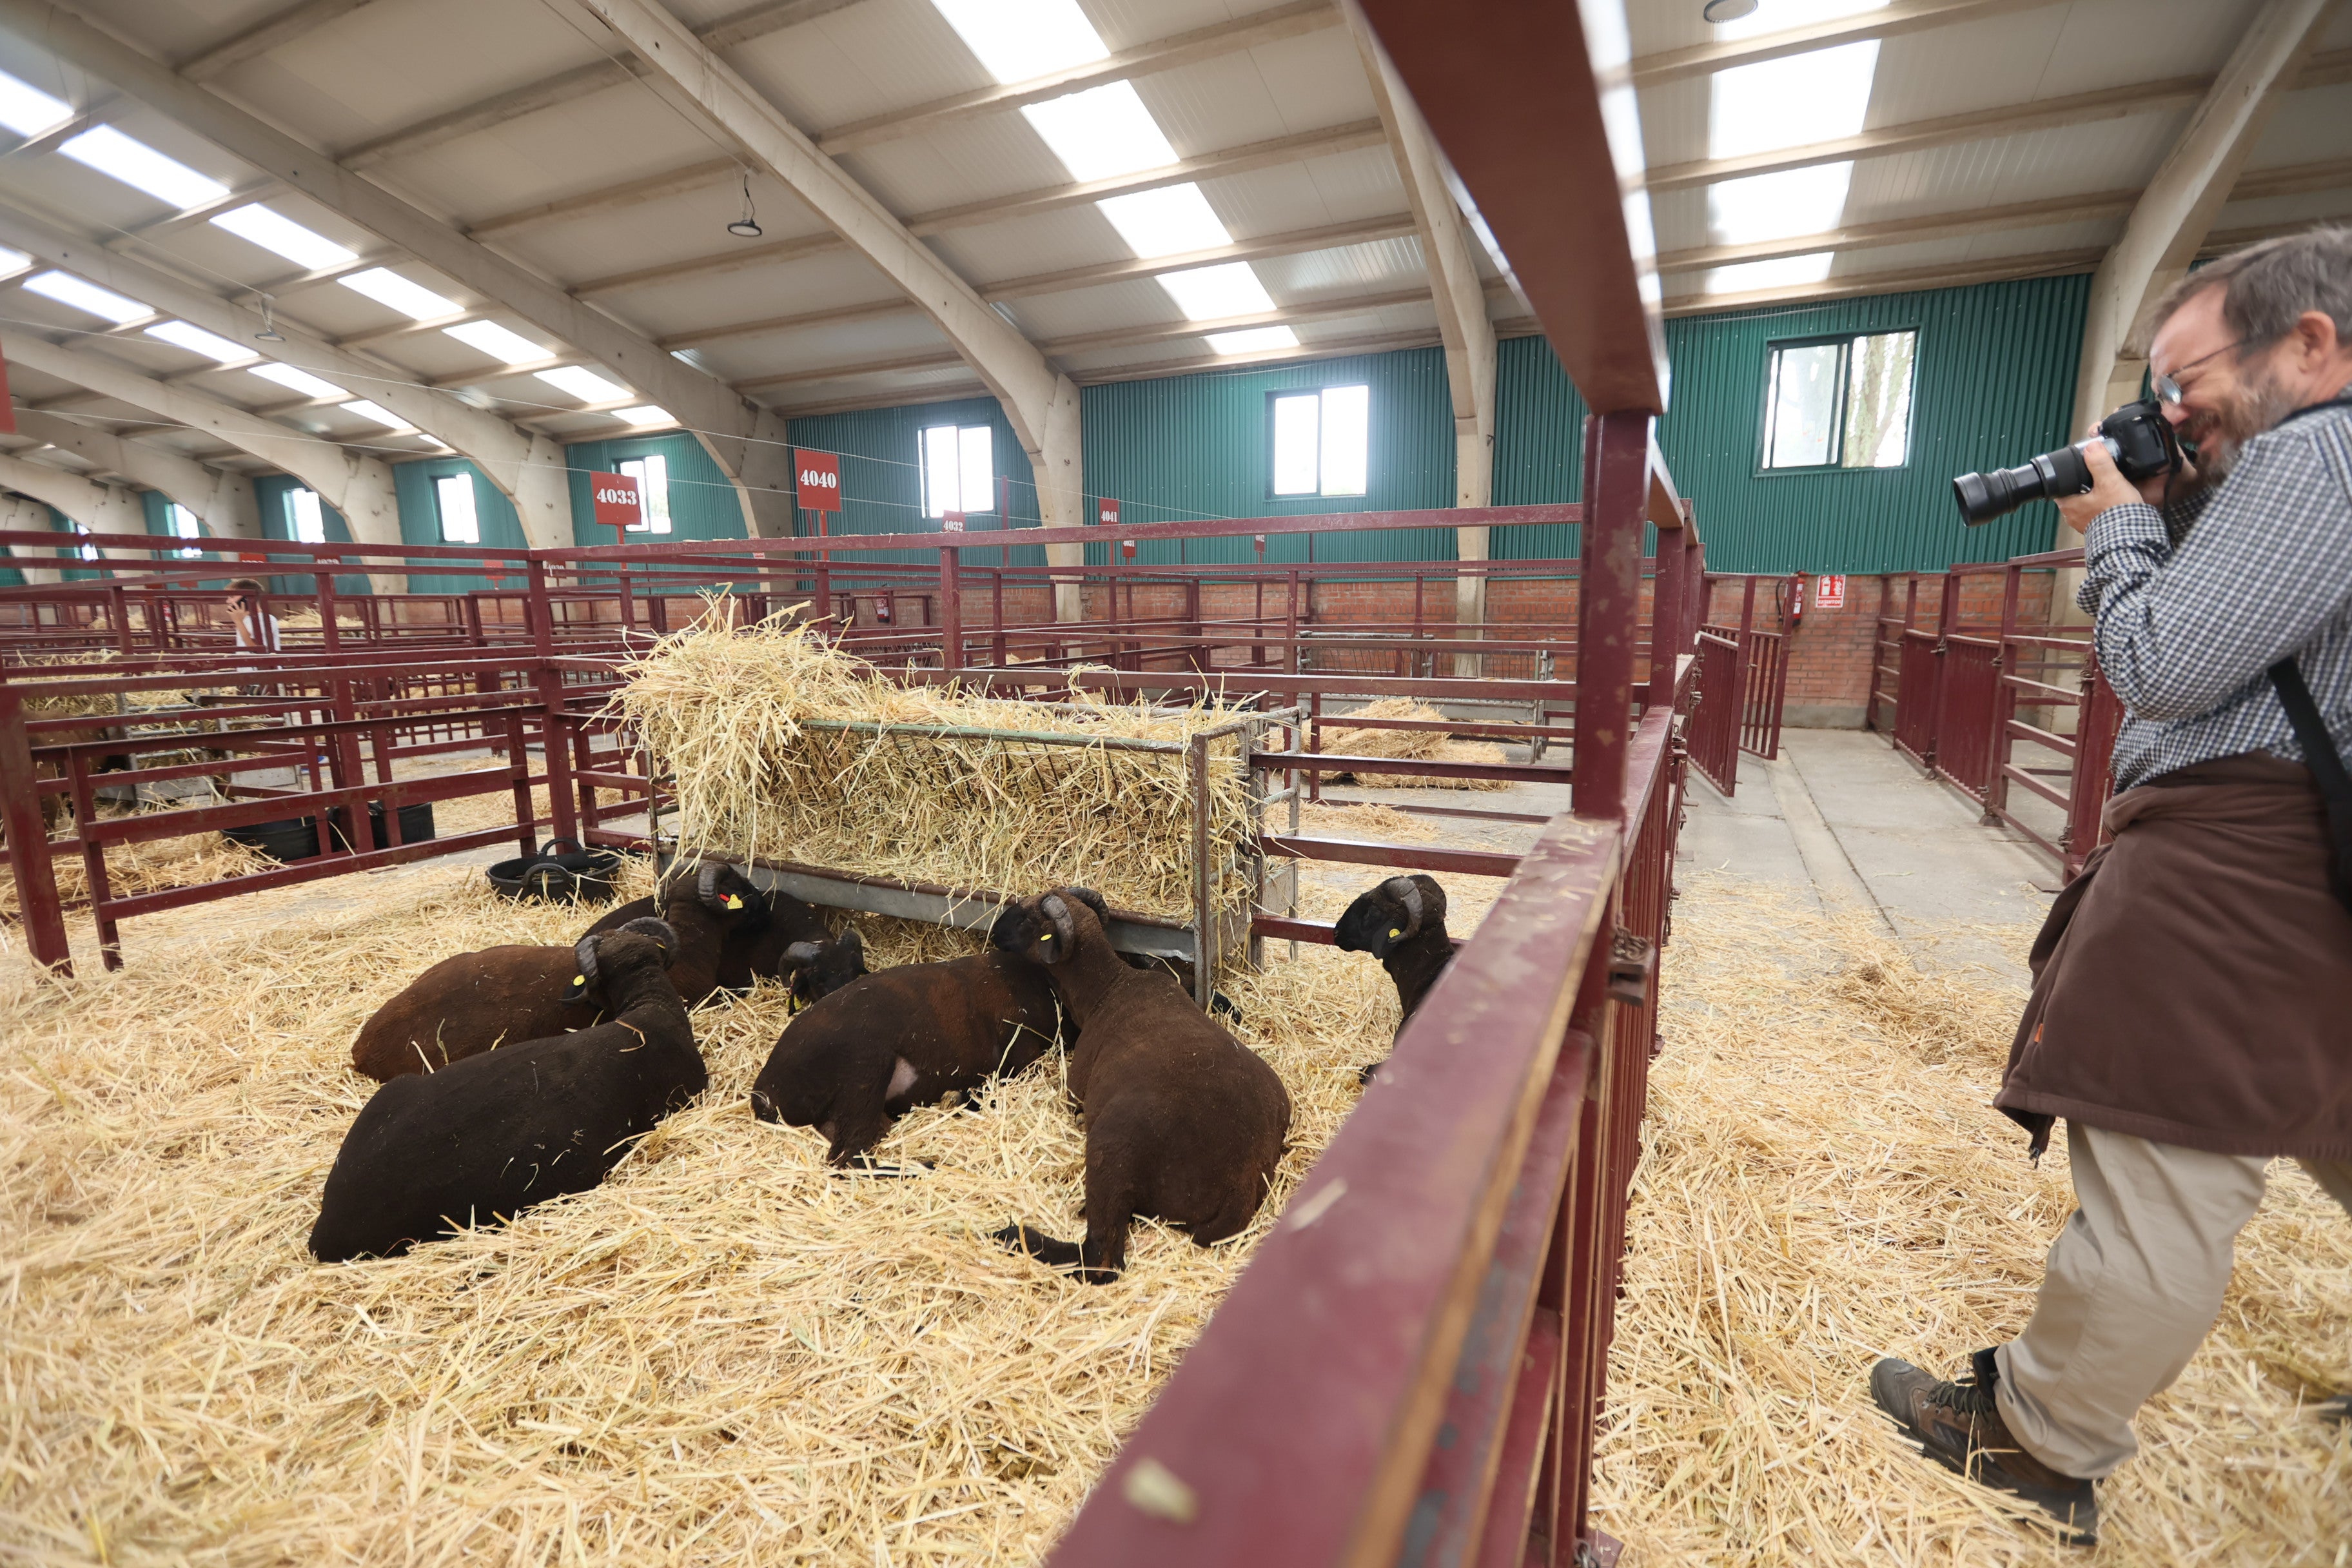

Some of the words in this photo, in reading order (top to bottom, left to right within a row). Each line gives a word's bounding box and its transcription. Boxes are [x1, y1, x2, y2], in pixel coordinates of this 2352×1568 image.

[800, 469, 837, 489] 4040
[596, 488, 637, 505] 4033
[1101, 510, 1117, 522] 4041
[943, 520, 963, 532] 4032
